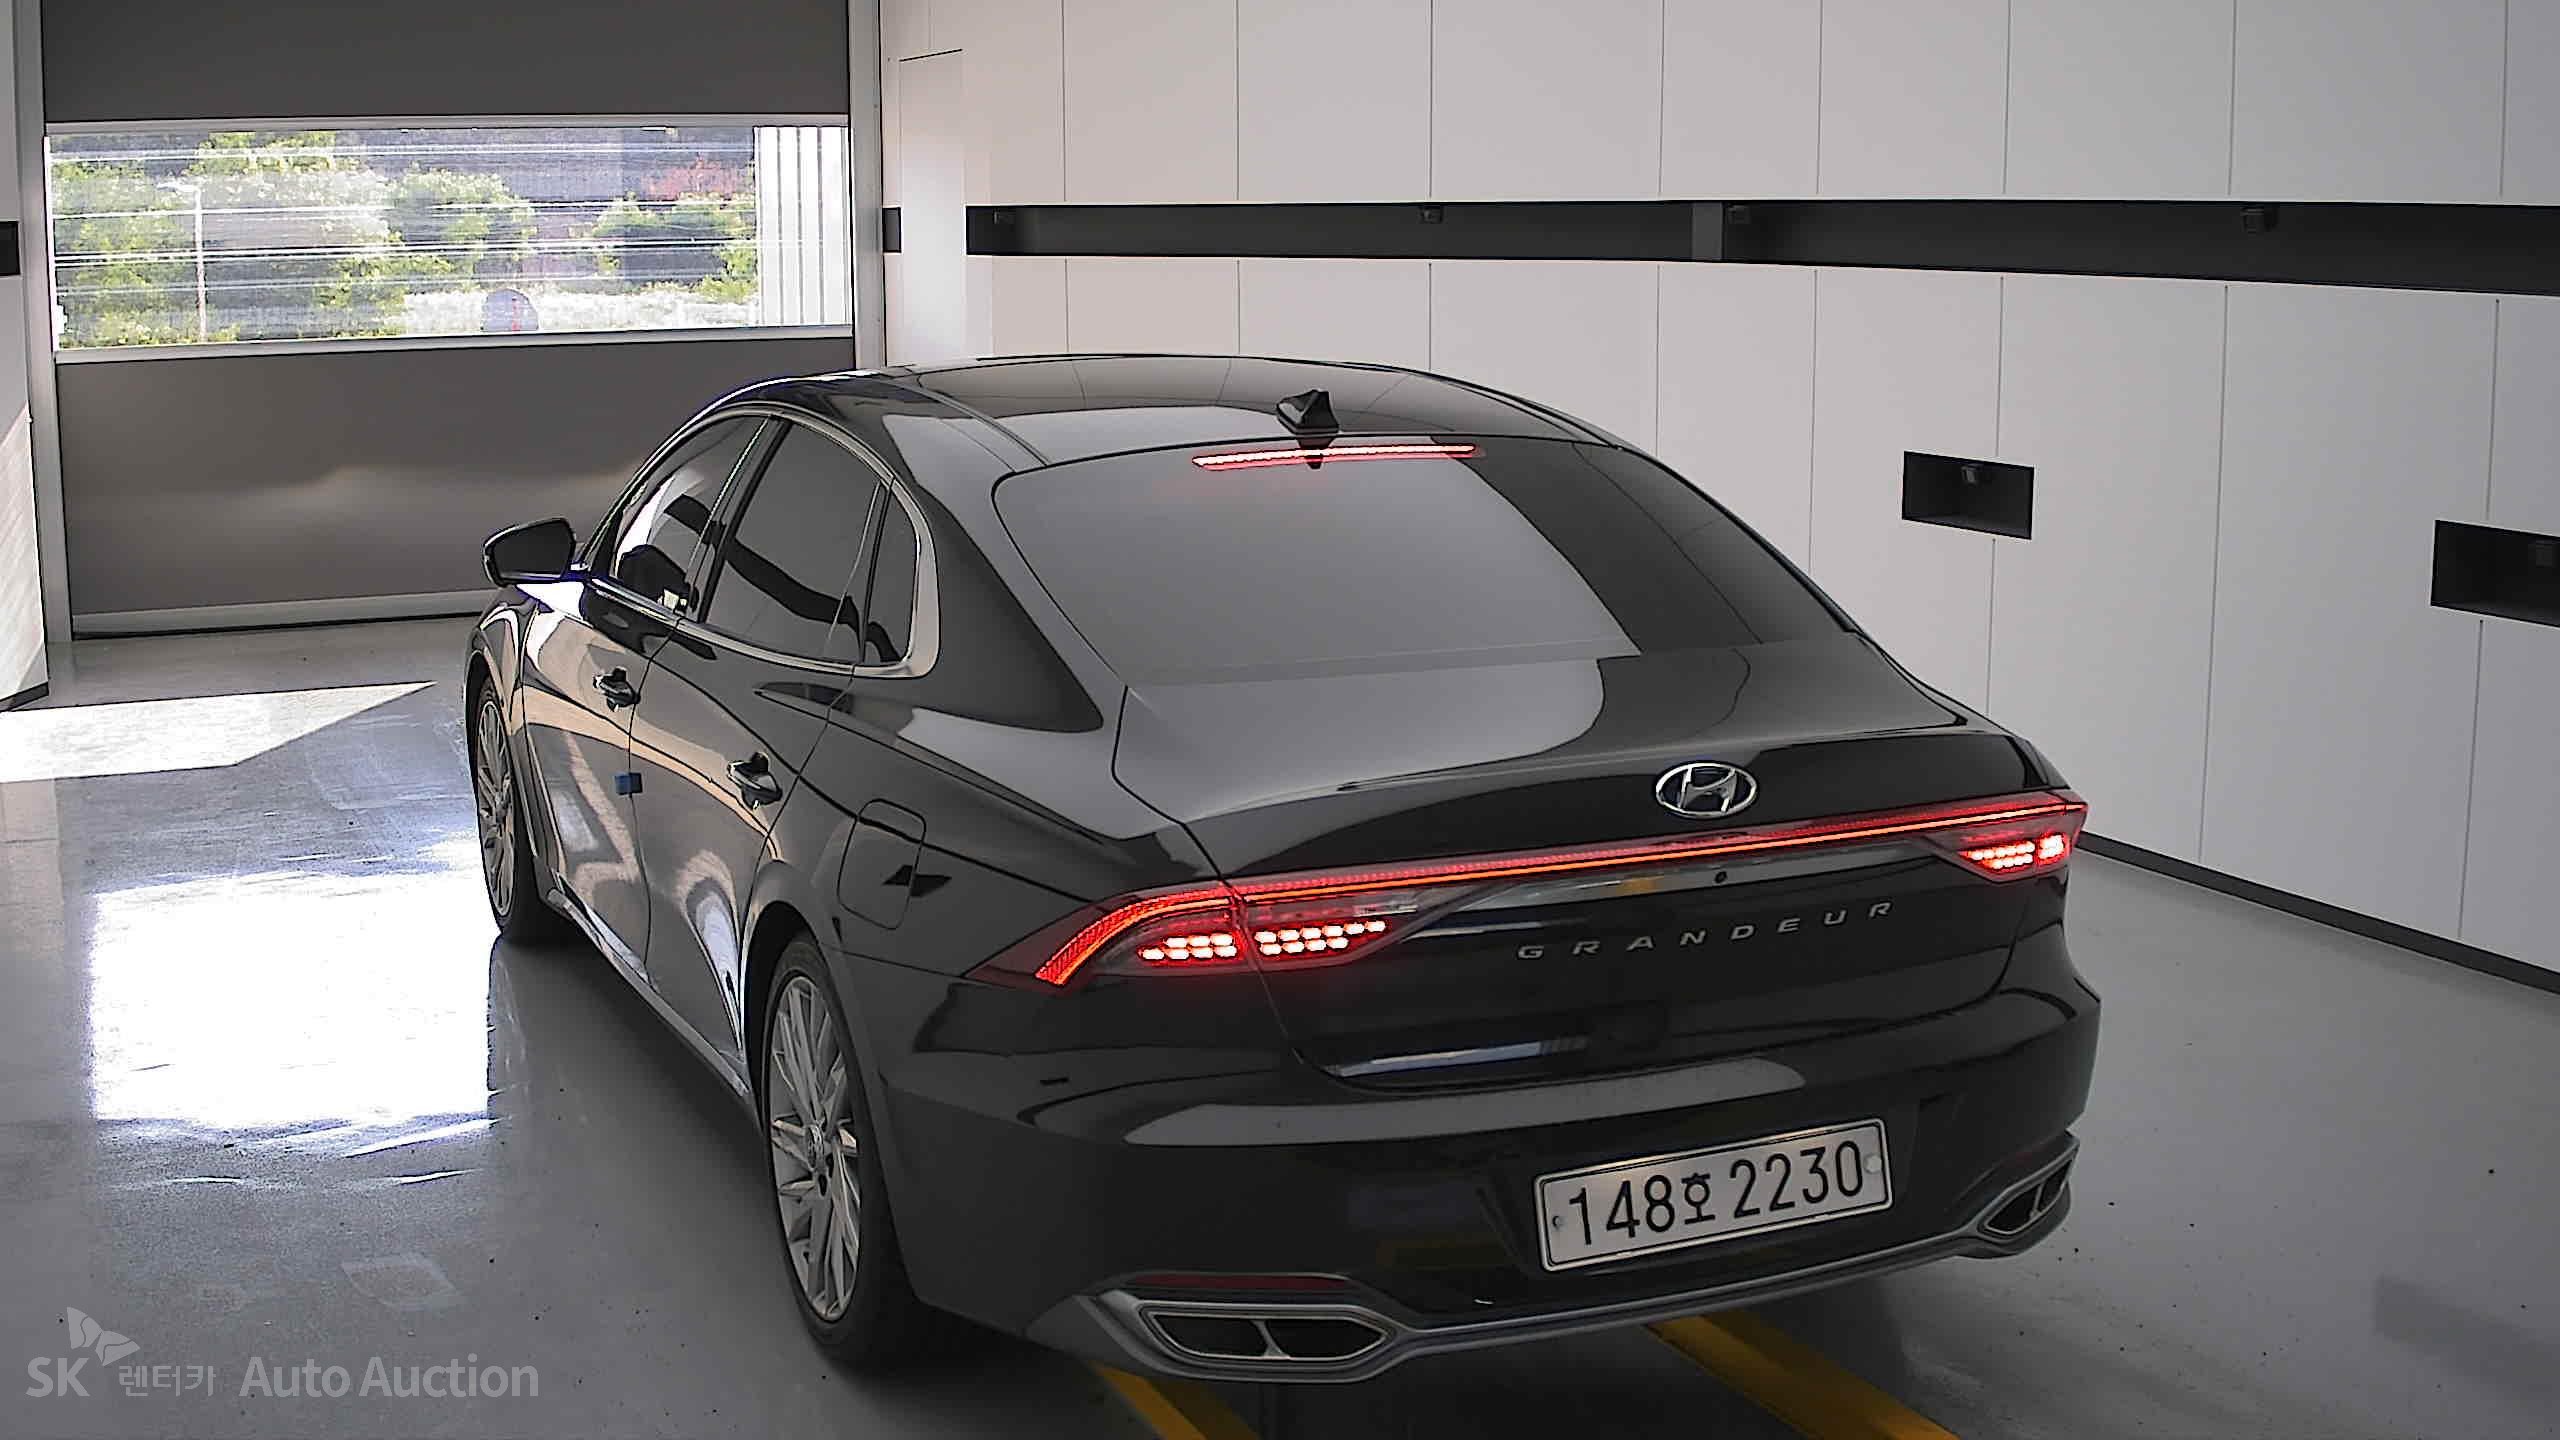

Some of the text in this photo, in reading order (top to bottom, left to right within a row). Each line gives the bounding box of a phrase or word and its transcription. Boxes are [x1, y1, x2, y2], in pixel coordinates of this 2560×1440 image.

[1516, 901, 1893, 960] GRANDEUR
[1569, 1140, 1864, 1246] 148호 2230
